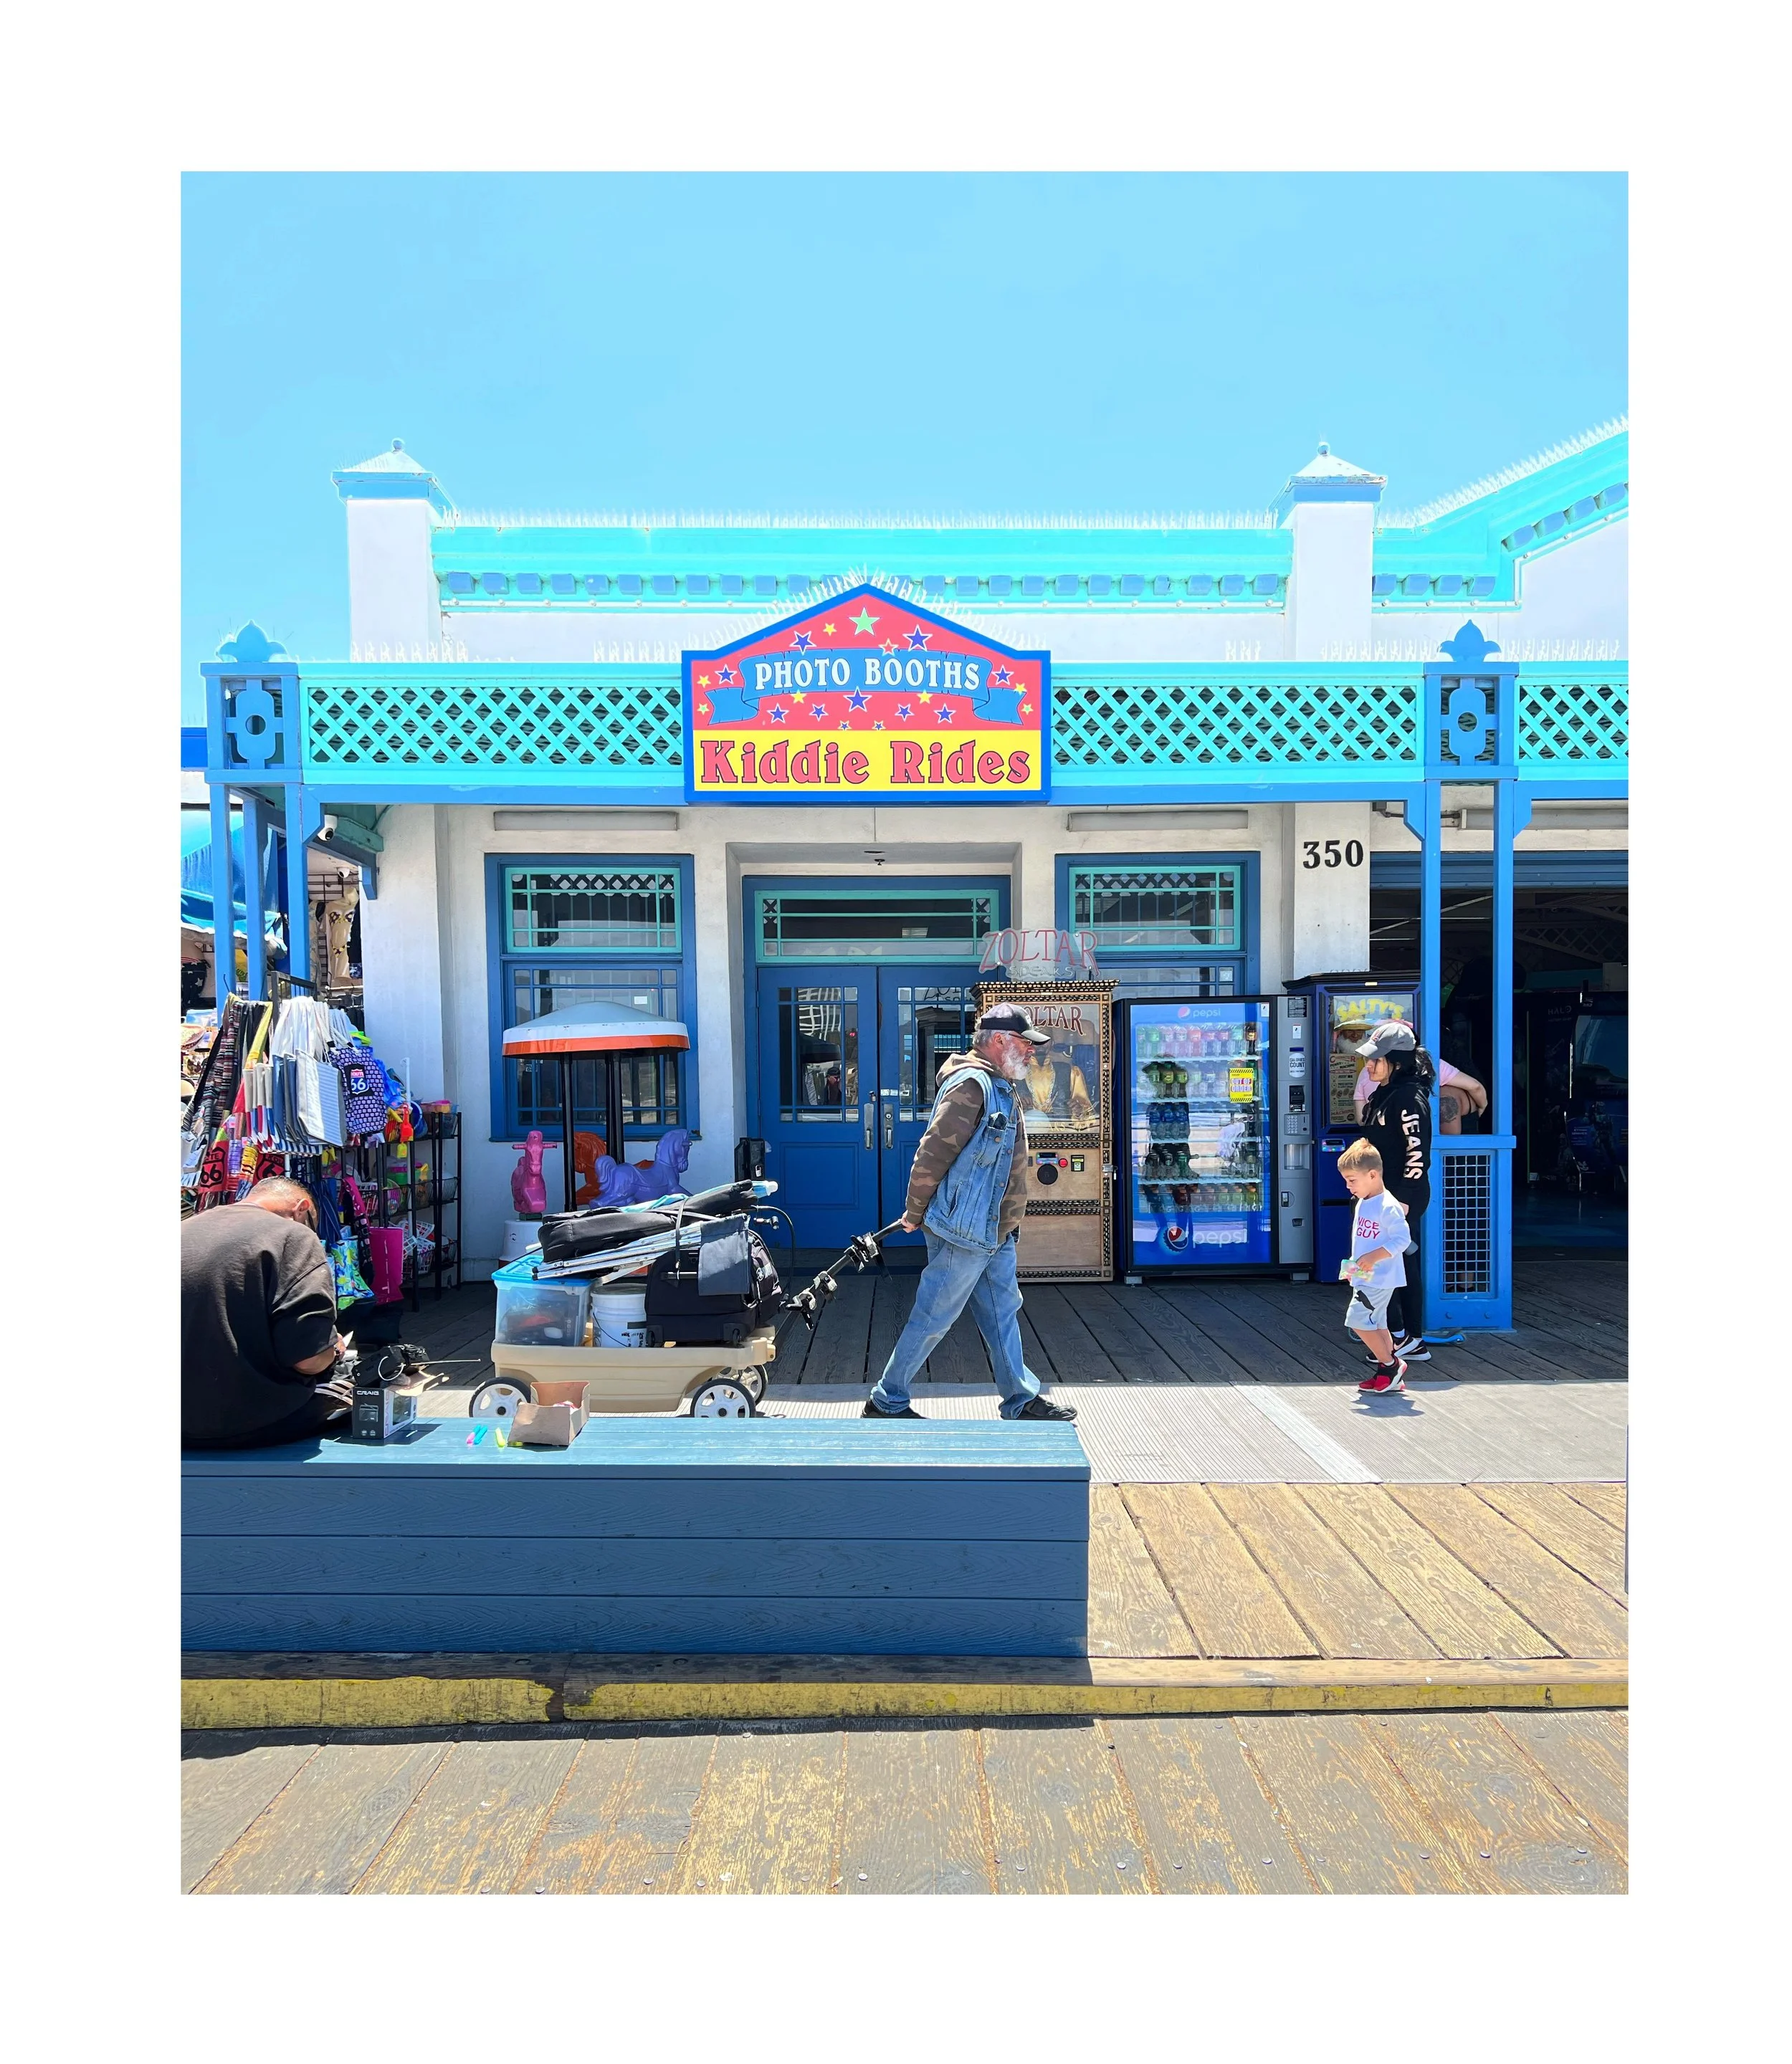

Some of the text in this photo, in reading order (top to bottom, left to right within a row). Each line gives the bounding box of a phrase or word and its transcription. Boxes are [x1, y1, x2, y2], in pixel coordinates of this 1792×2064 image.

[755, 657, 980, 691] PHOTO BOOTHS
[700, 740, 1031, 784] Kiddie Rides
[1302, 839, 1364, 869] 350
[981, 930, 1100, 977] ZOLTAR
[1024, 1005, 1084, 1036] OLTAR
[1193, 1008, 1221, 1018] pepsi
[1337, 998, 1404, 1023] SALTY'S
[351, 1078, 366, 1091] 66
[1401, 1109, 1424, 1180] JEANS
[201, 1163, 223, 1183] 66
[1356, 1227, 1381, 1239] GUY
[1358, 1216, 1379, 1230] NICE
[1193, 1228, 1247, 1248] pepsi
